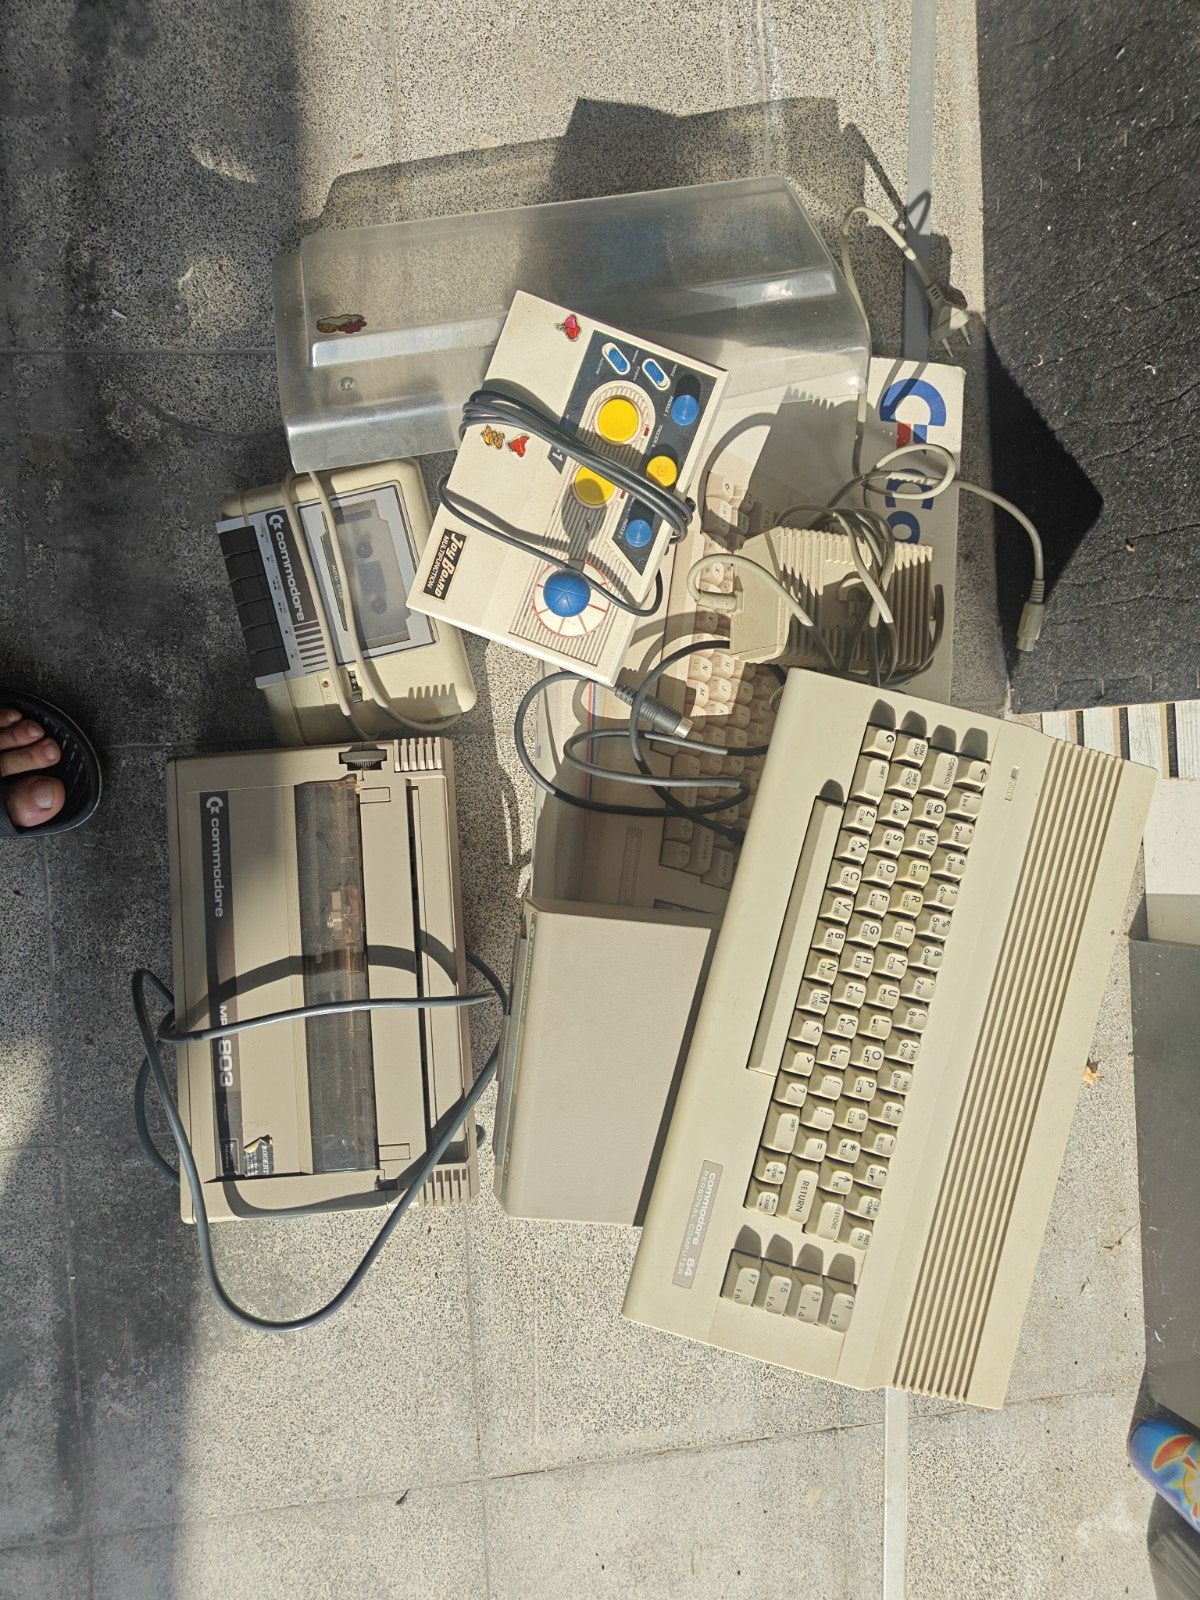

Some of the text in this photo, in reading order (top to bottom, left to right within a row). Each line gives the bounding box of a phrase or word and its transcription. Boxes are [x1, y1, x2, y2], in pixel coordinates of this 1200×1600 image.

[427, 535, 449, 588] MULTIFUNCTION
[276, 531, 305, 621] commodore
[331, 564, 339, 581] AUTO
[879, 765, 887, 778] SHIFT
[943, 757, 956, 785] CONTROL
[211, 818, 224, 918] commodore
[218, 1005, 233, 1087] MP 803
[795, 1180, 810, 1213] RETURN
[677, 1170, 709, 1275] PERSONAL COMPUTER
[684, 1172, 716, 1277] commodore 64
[748, 1274, 757, 1284] F7
[733, 1288, 742, 1299] F8
[780, 1282, 789, 1293] F5
[765, 1296, 773, 1307] F6
[812, 1291, 820, 1302] F3
[797, 1306, 806, 1317] F4
[844, 1300, 854, 1310] F1
[829, 1313, 838, 1325] F2
